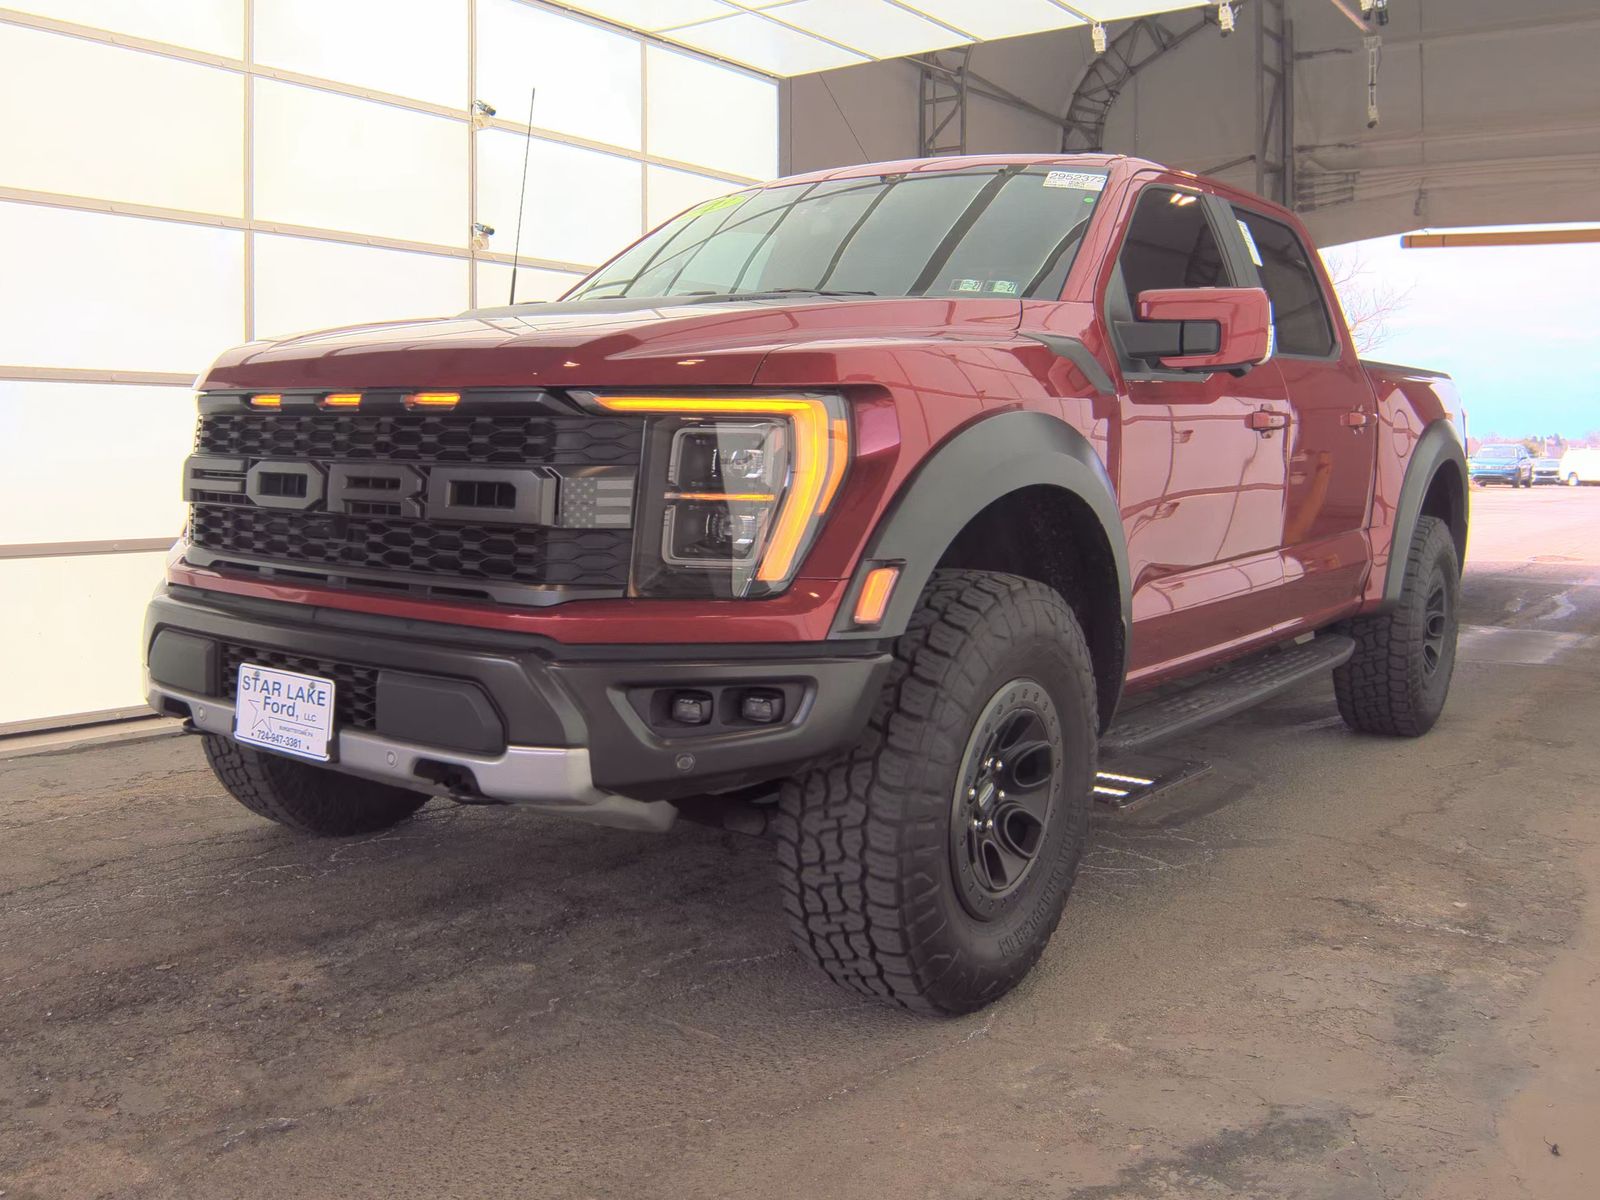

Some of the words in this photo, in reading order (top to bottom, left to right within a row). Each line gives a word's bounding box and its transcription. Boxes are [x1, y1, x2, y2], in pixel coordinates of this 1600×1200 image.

[1049, 172, 1106, 183] 2952372
[183, 454, 558, 528] FORD
[242, 675, 282, 697] STAR
[287, 684, 326, 707] LAKE
[263, 695, 299, 722] Ford,
[303, 712, 317, 722] LLC
[257, 729, 302, 749] 724-947-3381
